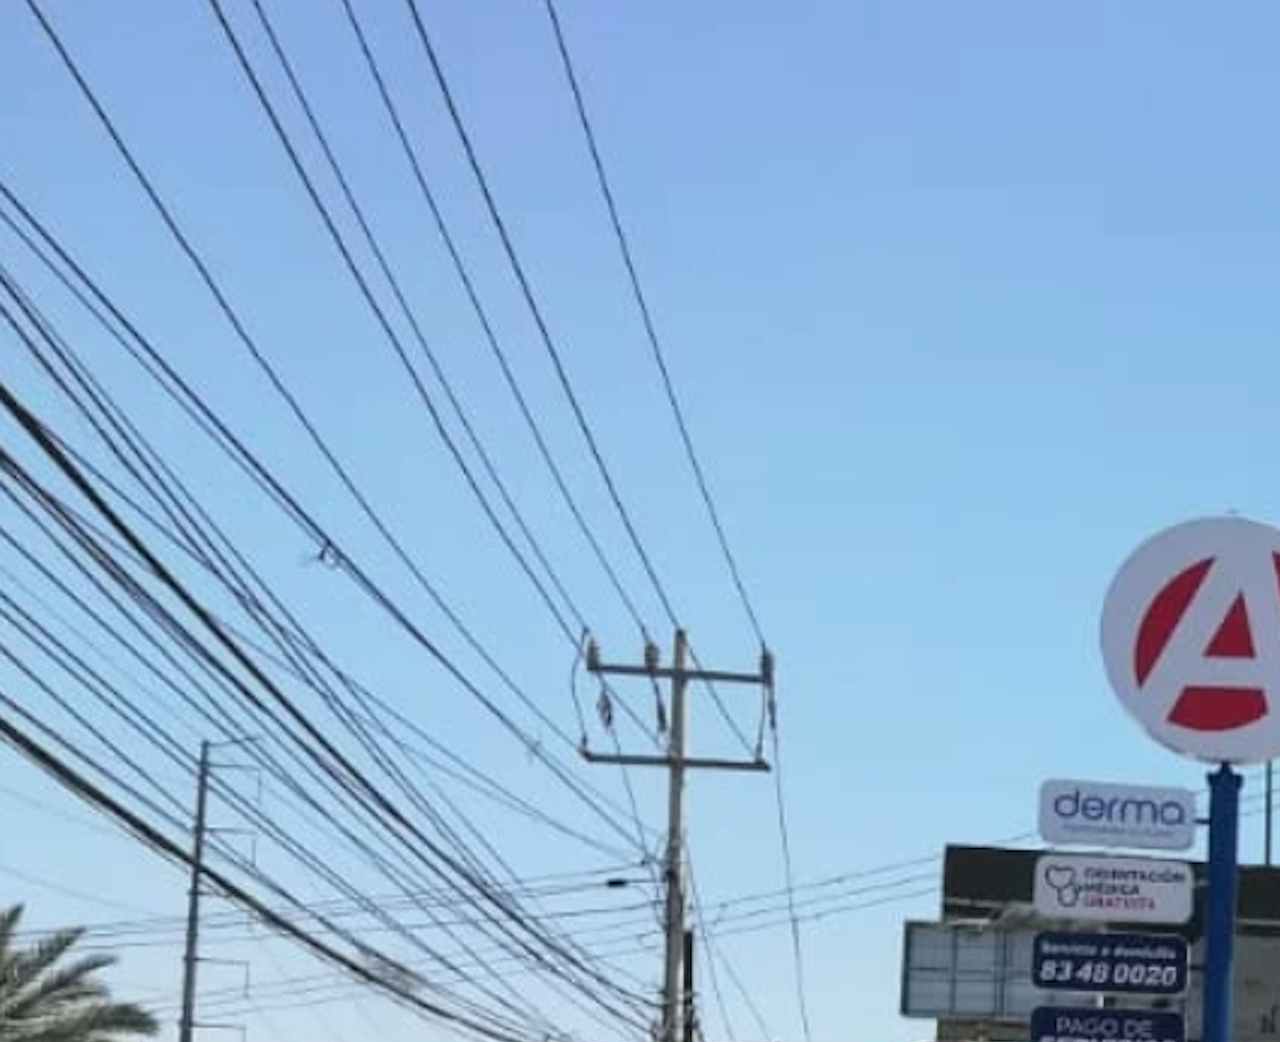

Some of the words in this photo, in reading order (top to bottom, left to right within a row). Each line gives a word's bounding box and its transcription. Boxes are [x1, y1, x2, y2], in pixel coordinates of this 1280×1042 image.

[1053, 788, 1185, 825] derma
[1056, 1016, 1118, 1036] PAGO
[1123, 1019, 1153, 1038] DE
